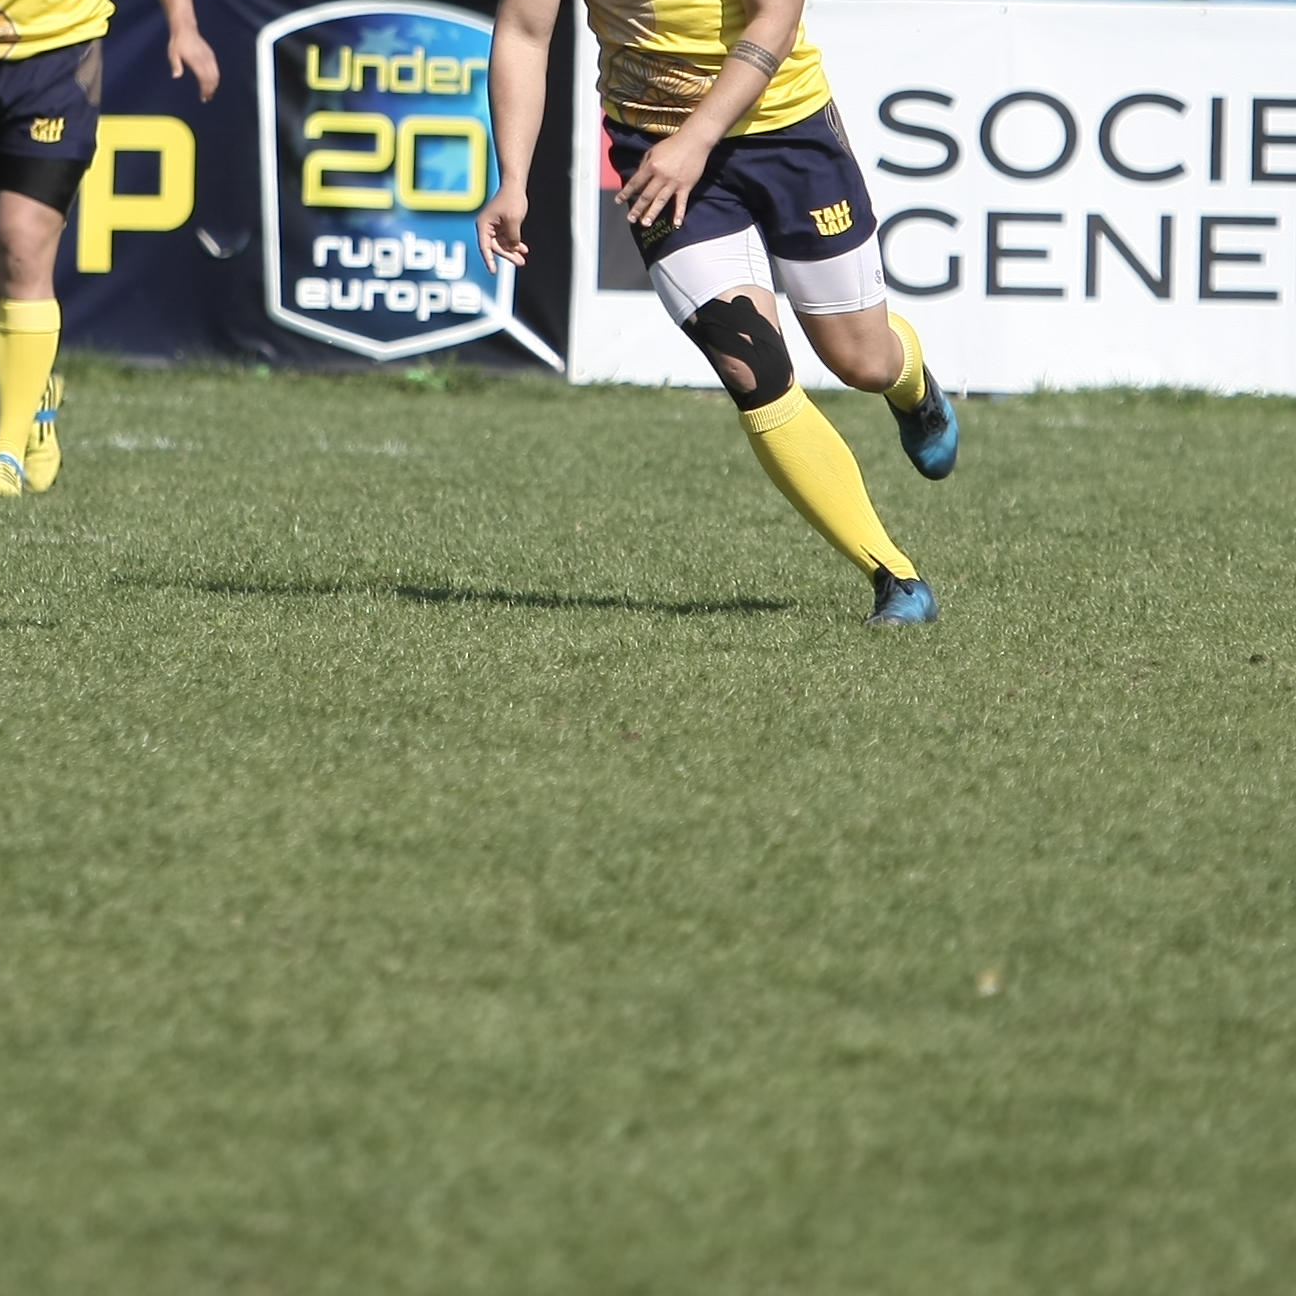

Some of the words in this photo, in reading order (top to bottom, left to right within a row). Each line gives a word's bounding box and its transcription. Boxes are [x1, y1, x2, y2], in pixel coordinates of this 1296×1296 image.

[307, 45, 489, 95] Under
[302, 111, 488, 212] 20
[808, 199, 851, 223] TALL
[815, 212, 853, 236] BALL
[313, 231, 467, 280] rugby
[295, 277, 483, 322] europe
